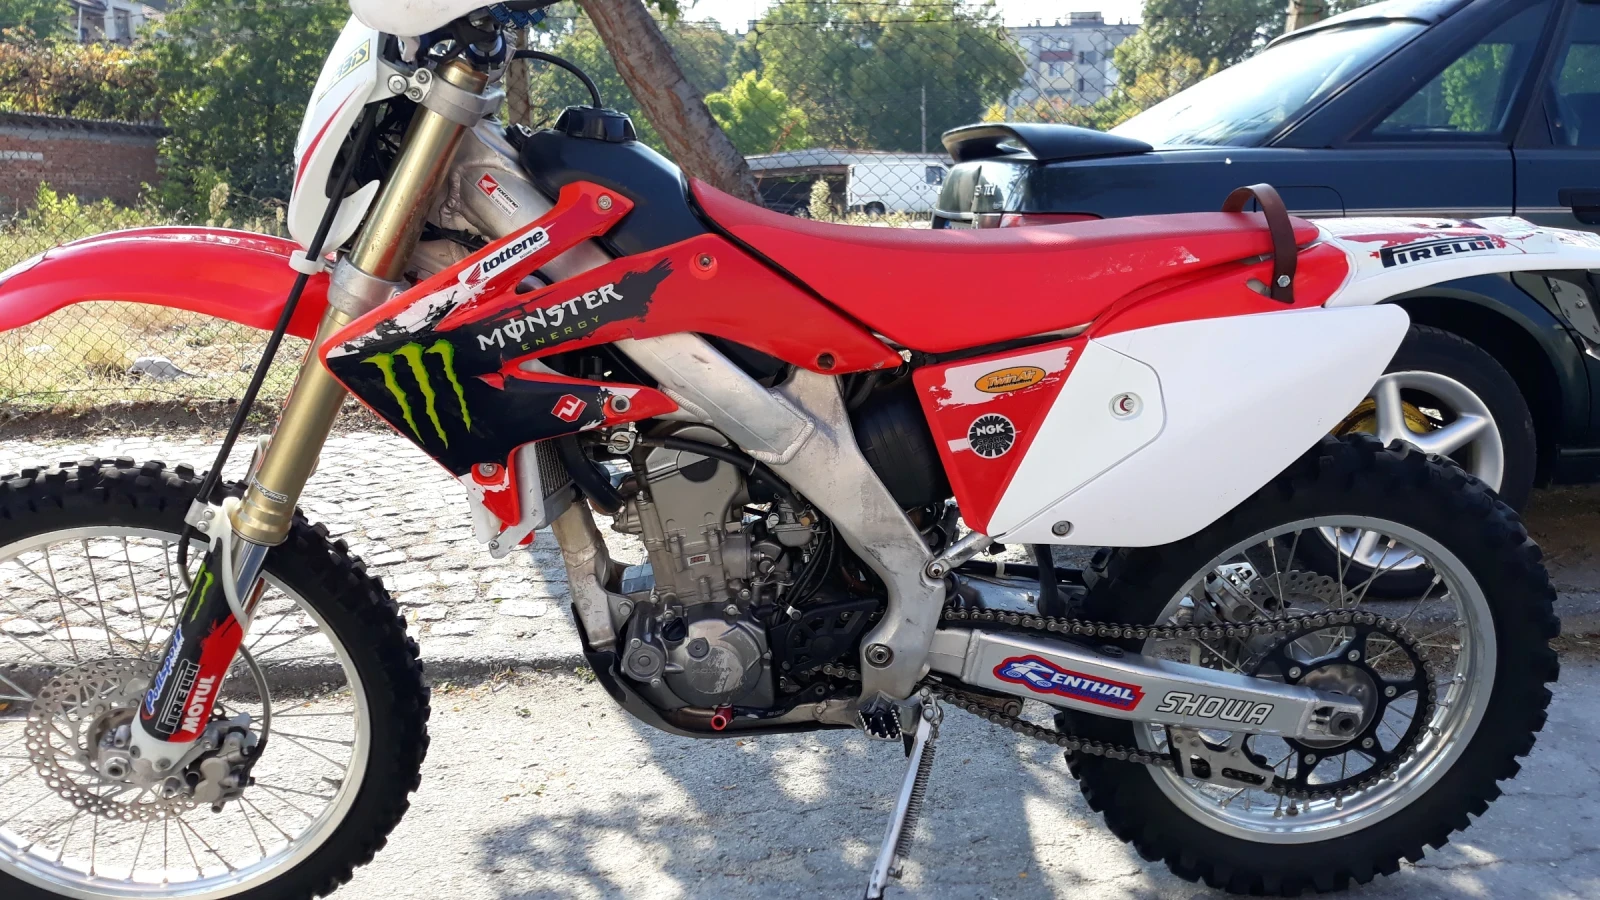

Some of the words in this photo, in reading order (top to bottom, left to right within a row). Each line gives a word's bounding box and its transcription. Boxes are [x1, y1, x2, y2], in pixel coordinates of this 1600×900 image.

[482, 231, 544, 273] tottene
[1379, 235, 1495, 268] PIRELLI
[477, 283, 624, 351] MONSTER
[521, 315, 600, 351] ENERGY
[976, 423, 1005, 437] NGK
[155, 659, 200, 734] PIRELLI
[182, 675, 216, 734] MOTUL
[1155, 690, 1275, 725] SHOWA
